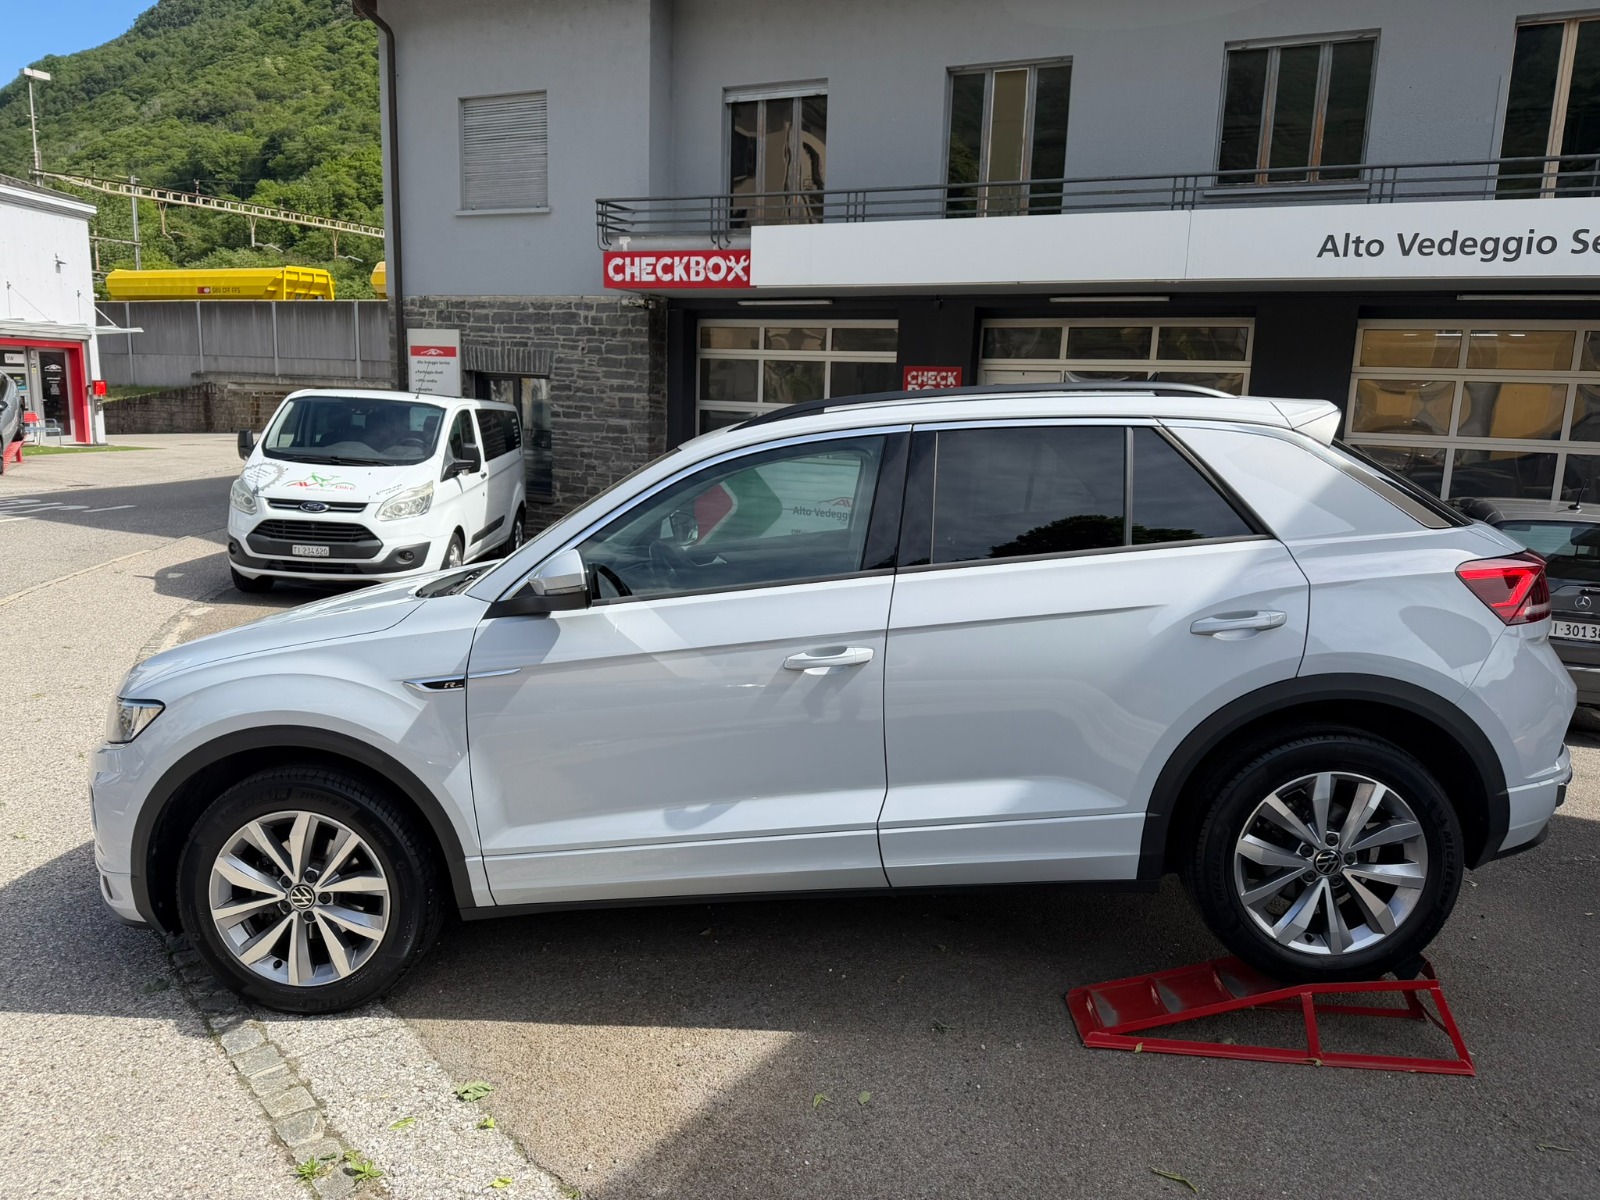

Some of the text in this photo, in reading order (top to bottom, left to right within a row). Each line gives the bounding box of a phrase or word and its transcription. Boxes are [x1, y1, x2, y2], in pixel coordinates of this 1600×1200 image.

[1316, 232, 1385, 258] Alto
[1396, 228, 1558, 263] Vedeggio
[607, 255, 750, 282] CHECKBOX
[907, 370, 958, 386] CHECK
[792, 506, 850, 521] Alto Vedegg
